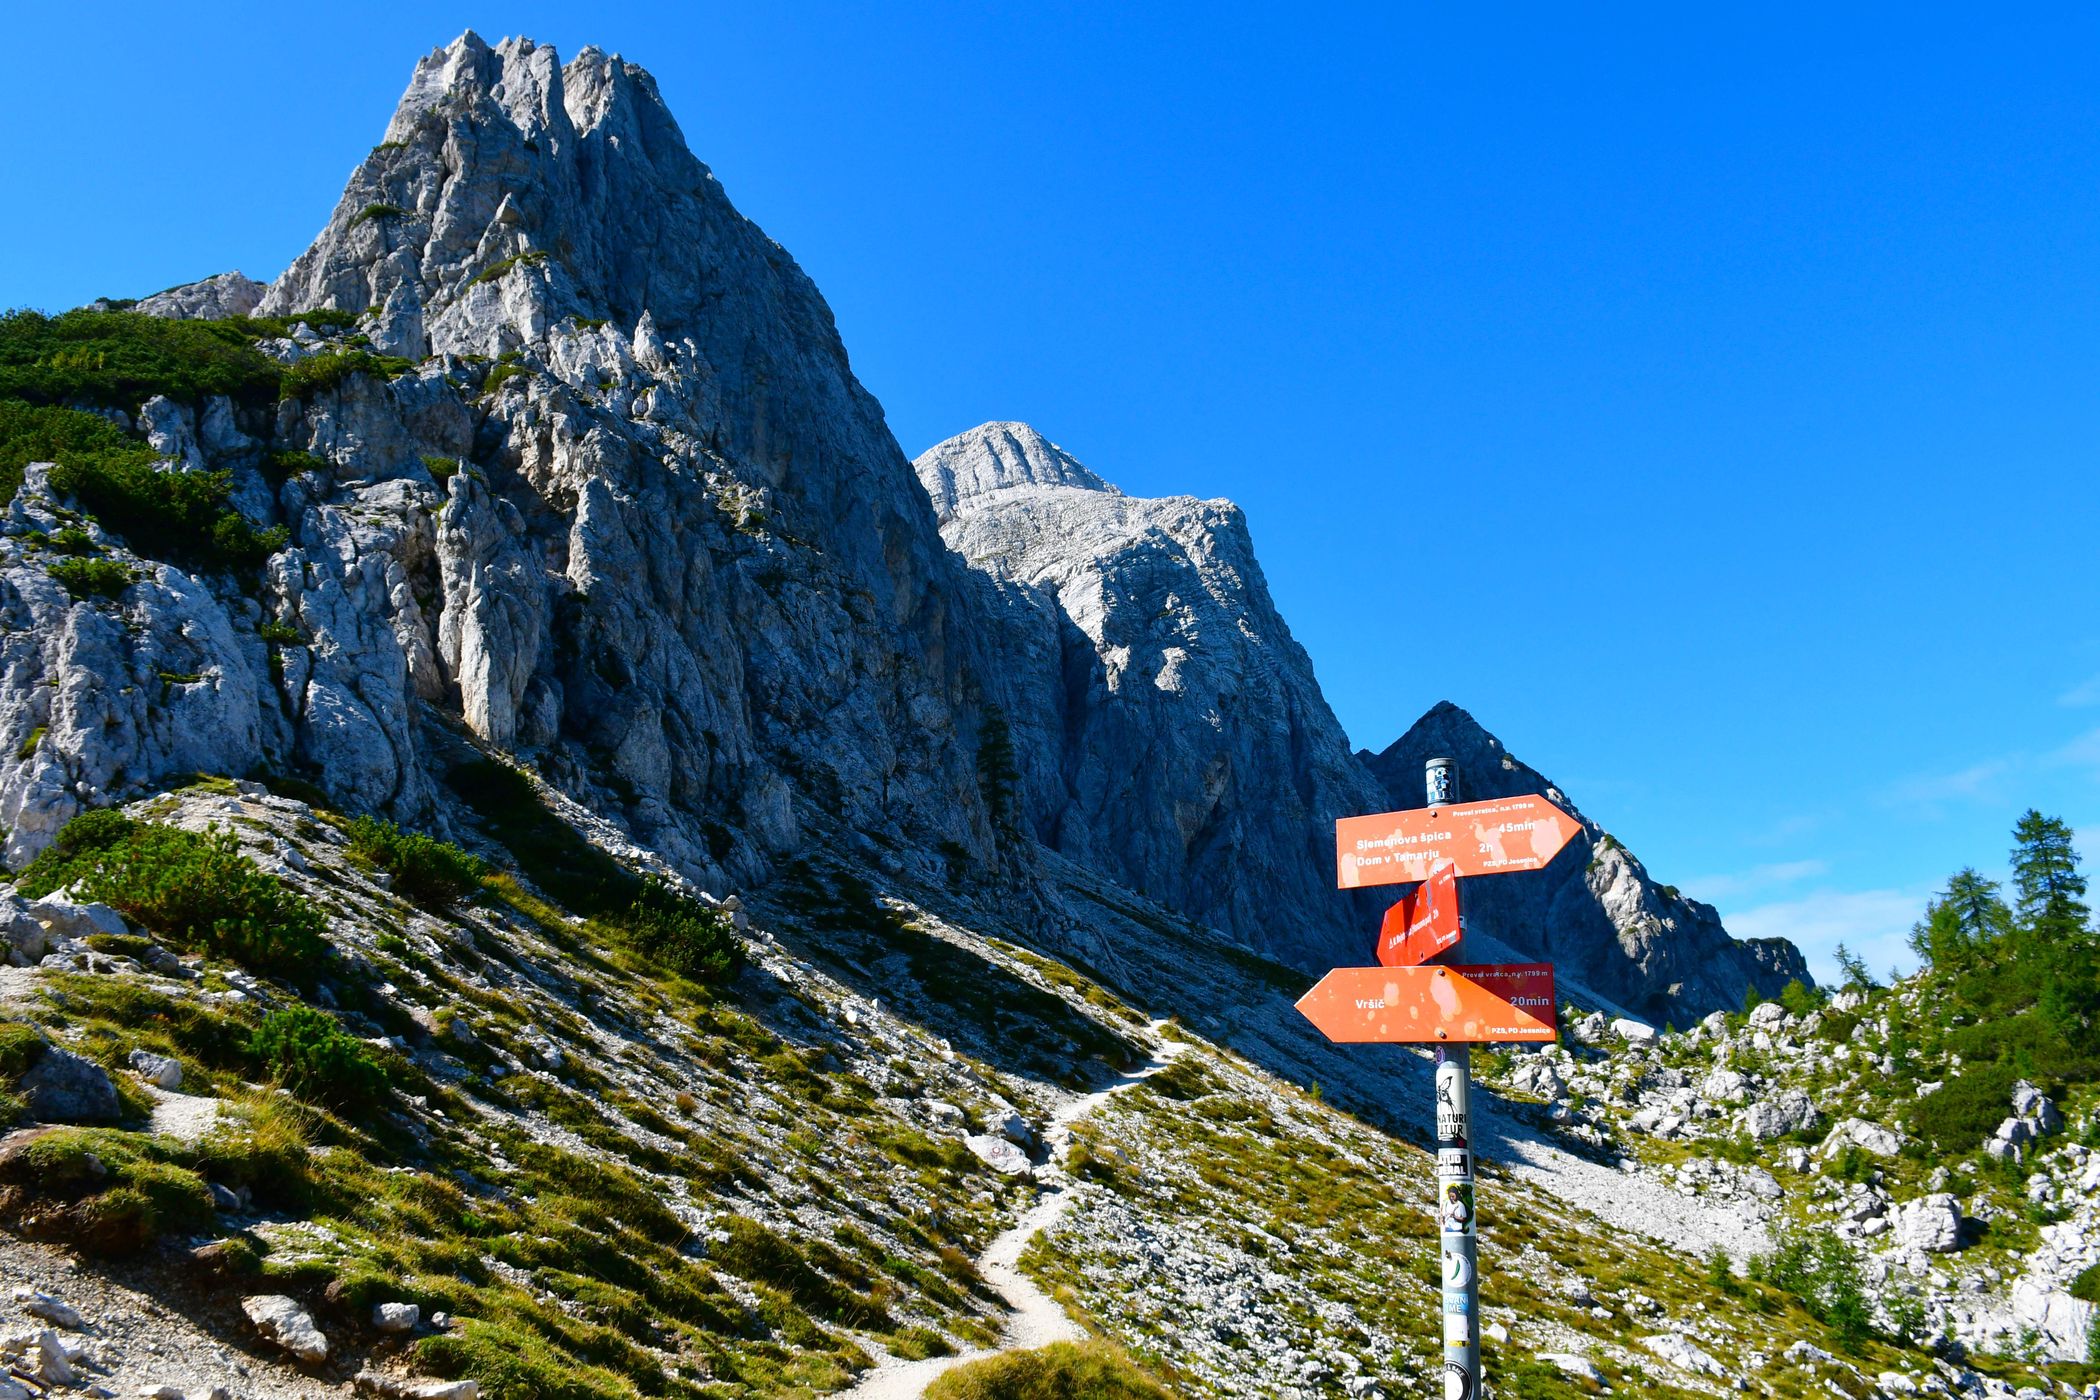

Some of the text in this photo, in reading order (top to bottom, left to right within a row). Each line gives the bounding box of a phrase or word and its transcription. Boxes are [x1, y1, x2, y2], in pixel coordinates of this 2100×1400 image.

[1498, 820, 1536, 833] 45min
[1420, 832, 1451, 844] špica
[1479, 843, 1493, 853] 2h
[1356, 849, 1440, 866] Dom v Tamarju
[1355, 998, 1385, 1009] Vršič
[1510, 995, 1550, 1007] 20min
[1518, 1026, 1551, 1035] Jesenice
